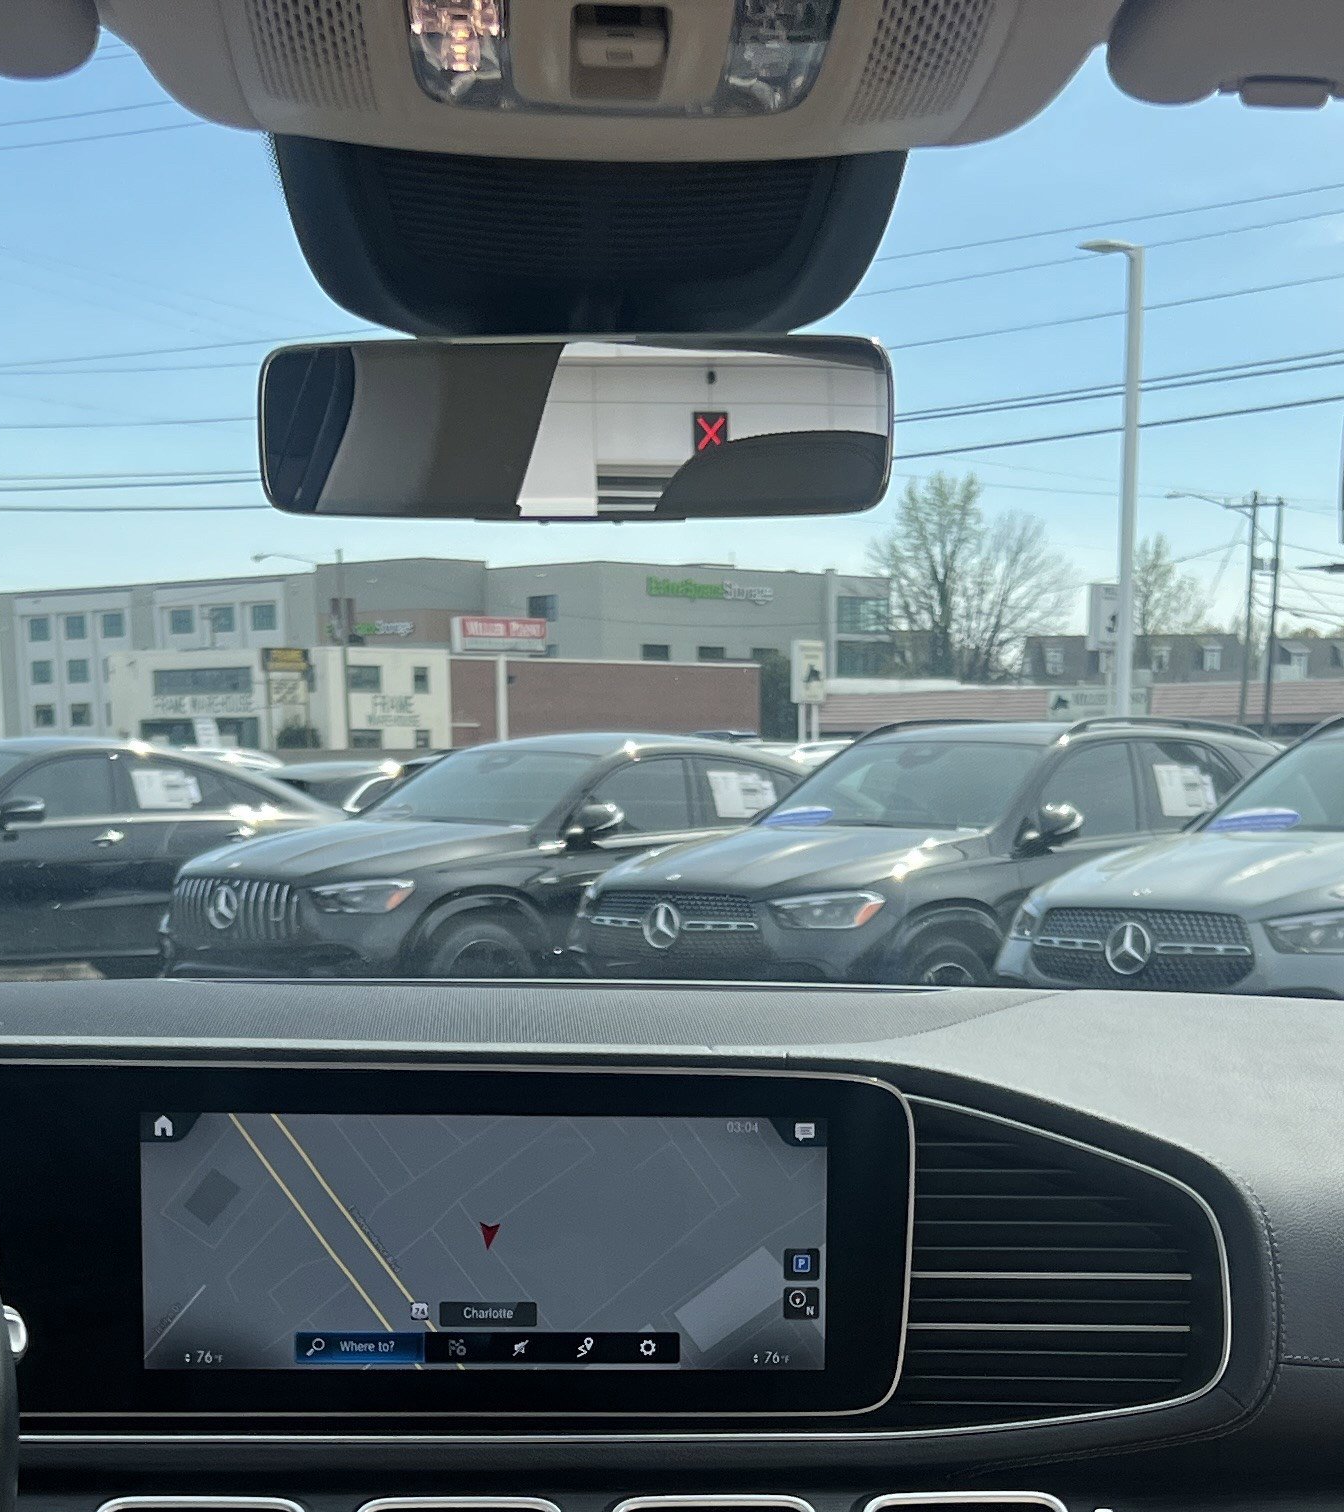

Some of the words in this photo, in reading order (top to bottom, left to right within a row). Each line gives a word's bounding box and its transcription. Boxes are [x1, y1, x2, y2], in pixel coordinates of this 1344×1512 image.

[726, 1121, 759, 1135] 03:04
[414, 1307, 426, 1316] 74
[463, 1306, 514, 1319] Charlotte
[805, 1305, 815, 1316] N
[339, 1340, 375, 1352] Where
[378, 1340, 395, 1352] to?
